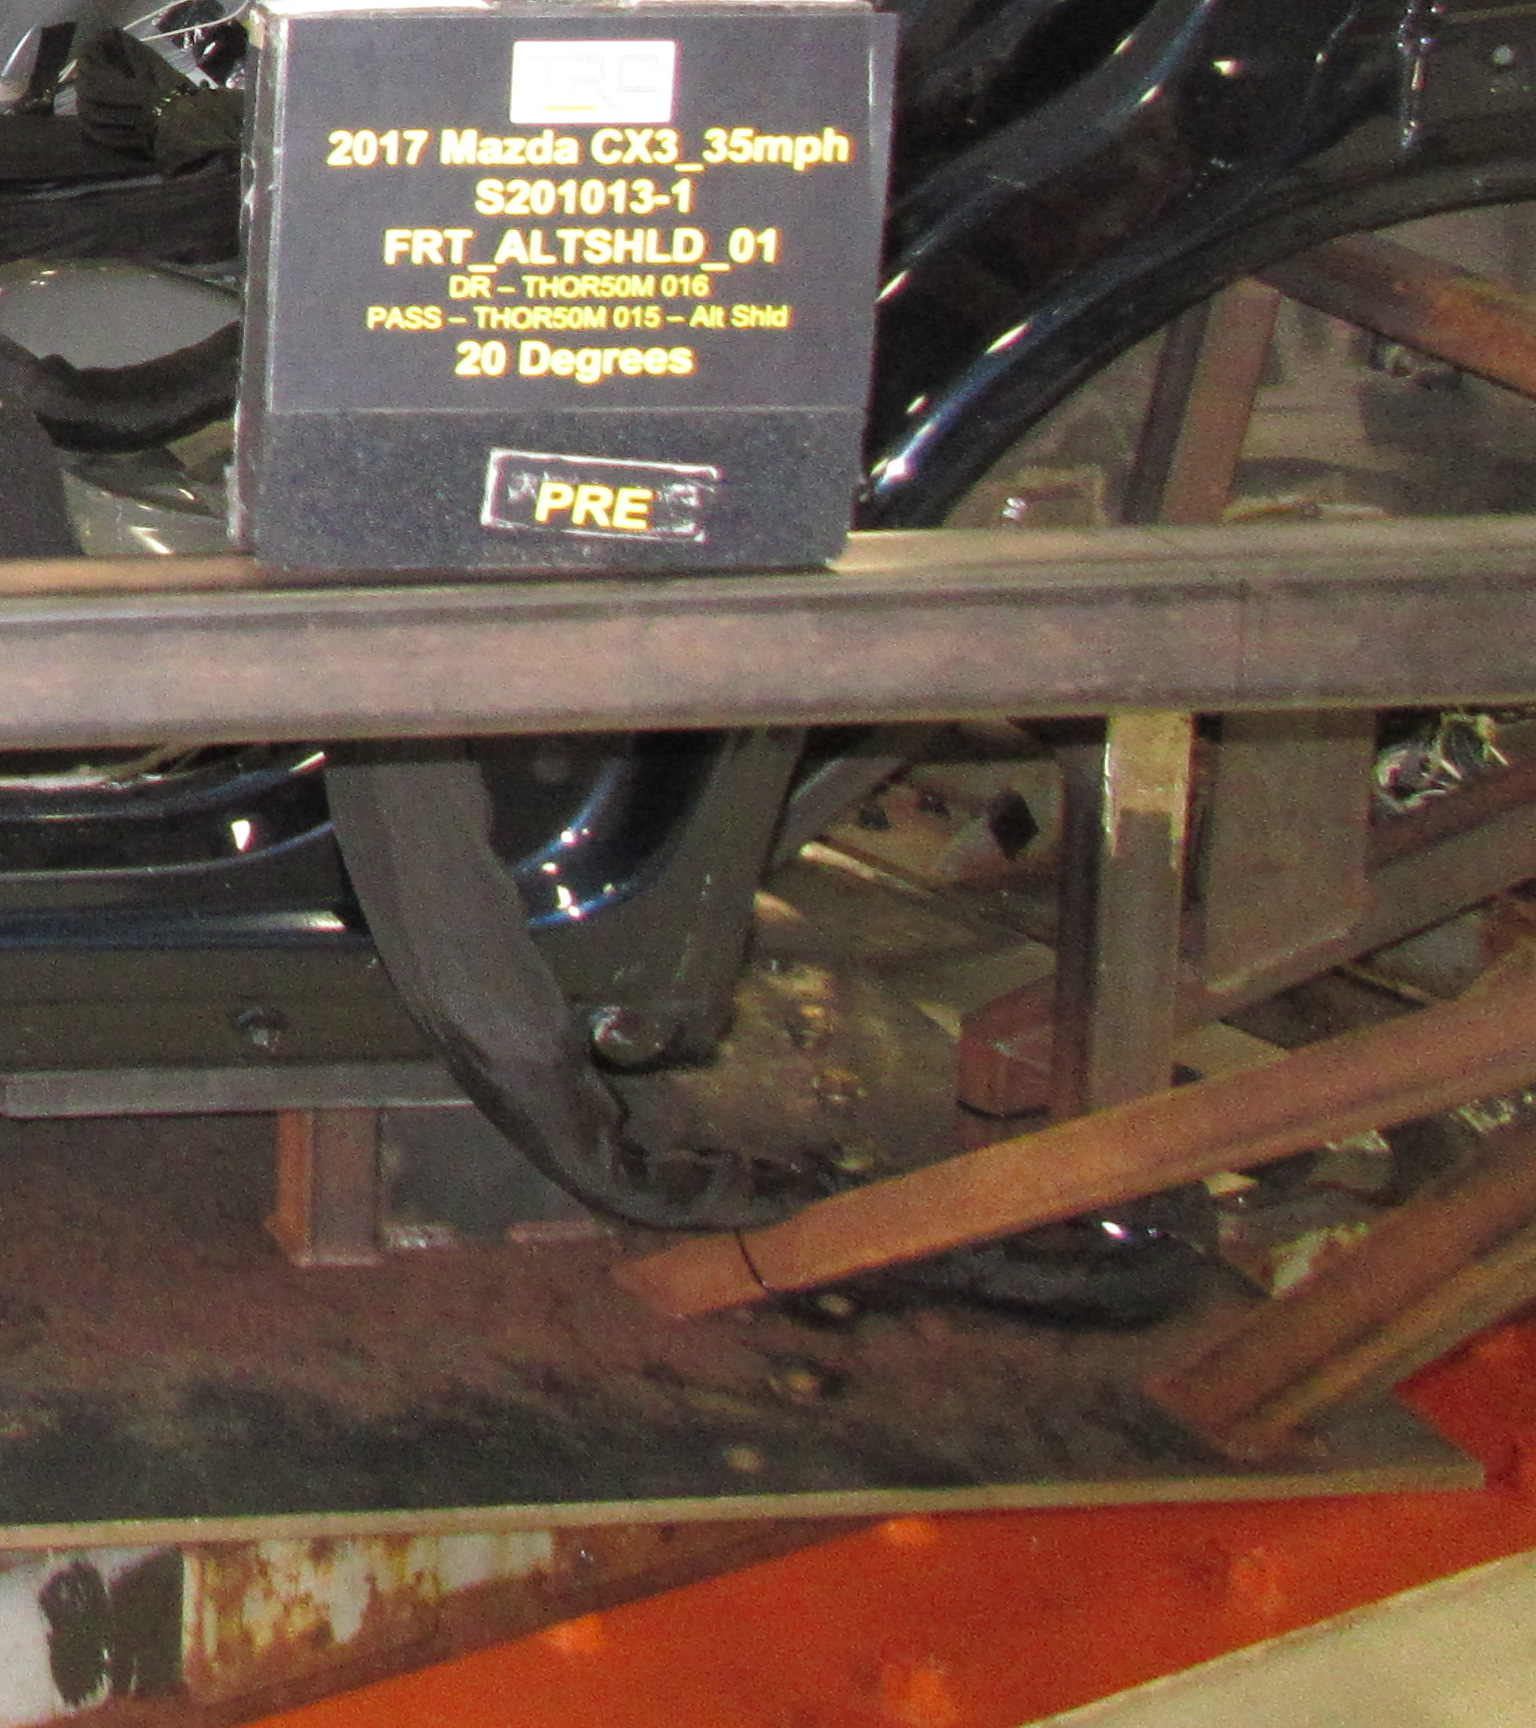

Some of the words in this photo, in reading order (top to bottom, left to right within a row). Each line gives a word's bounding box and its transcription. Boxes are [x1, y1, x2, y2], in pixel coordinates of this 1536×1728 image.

[326, 129, 430, 167] 2017
[439, 128, 580, 166] Mazda
[589, 127, 850, 172] CX3_35mph
[473, 179, 694, 215] S201013-1
[382, 227, 780, 274] FRT_ALTSHLD_01
[448, 275, 493, 300] DR
[522, 274, 656, 299] THOR50M
[660, 274, 710, 298] 016
[366, 306, 443, 331] PASS
[473, 306, 607, 331] THOR50M
[612, 305, 661, 330] 015
[688, 304, 726, 329] Alt
[730, 303, 790, 329] Shld
[454, 340, 507, 376] 20
[518, 339, 695, 385] Degrees
[534, 481, 654, 531] PRE
